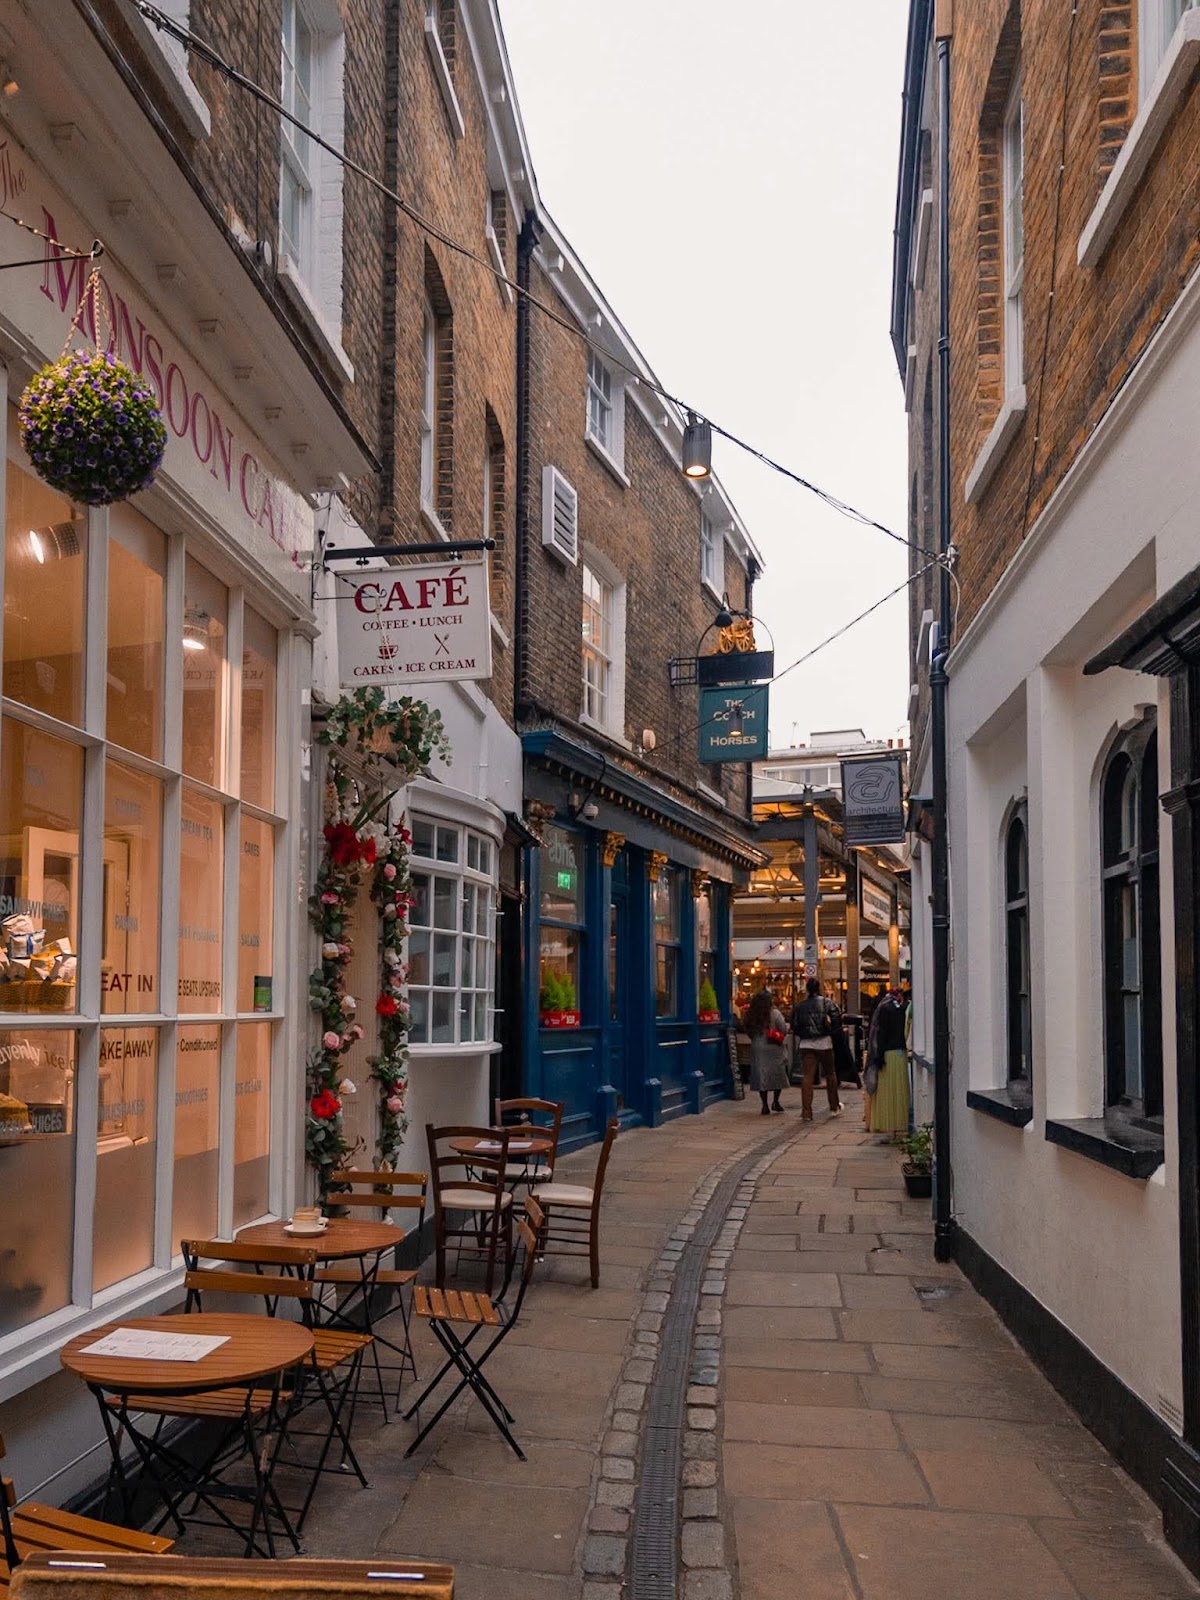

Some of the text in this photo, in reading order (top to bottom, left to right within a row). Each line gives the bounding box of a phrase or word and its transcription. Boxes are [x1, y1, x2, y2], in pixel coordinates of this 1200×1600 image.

[0, 141, 27, 212] The
[40, 204, 234, 493] MONSOON
[354, 567, 470, 615] CAFÉ
[362, 615, 463, 632] COFFEE LUNCH
[353, 658, 476, 676] CAKES ICE CREAM
[713, 710, 755, 722] COCH
[710, 735, 758, 747] HORSES
[847, 805, 900, 816] architecture
[101, 972, 153, 992] EAT IN
[100, 1041, 122, 1060] AKE
[124, 1039, 154, 1058] AWAY
[180, 1038, 218, 1052] Conditioned
